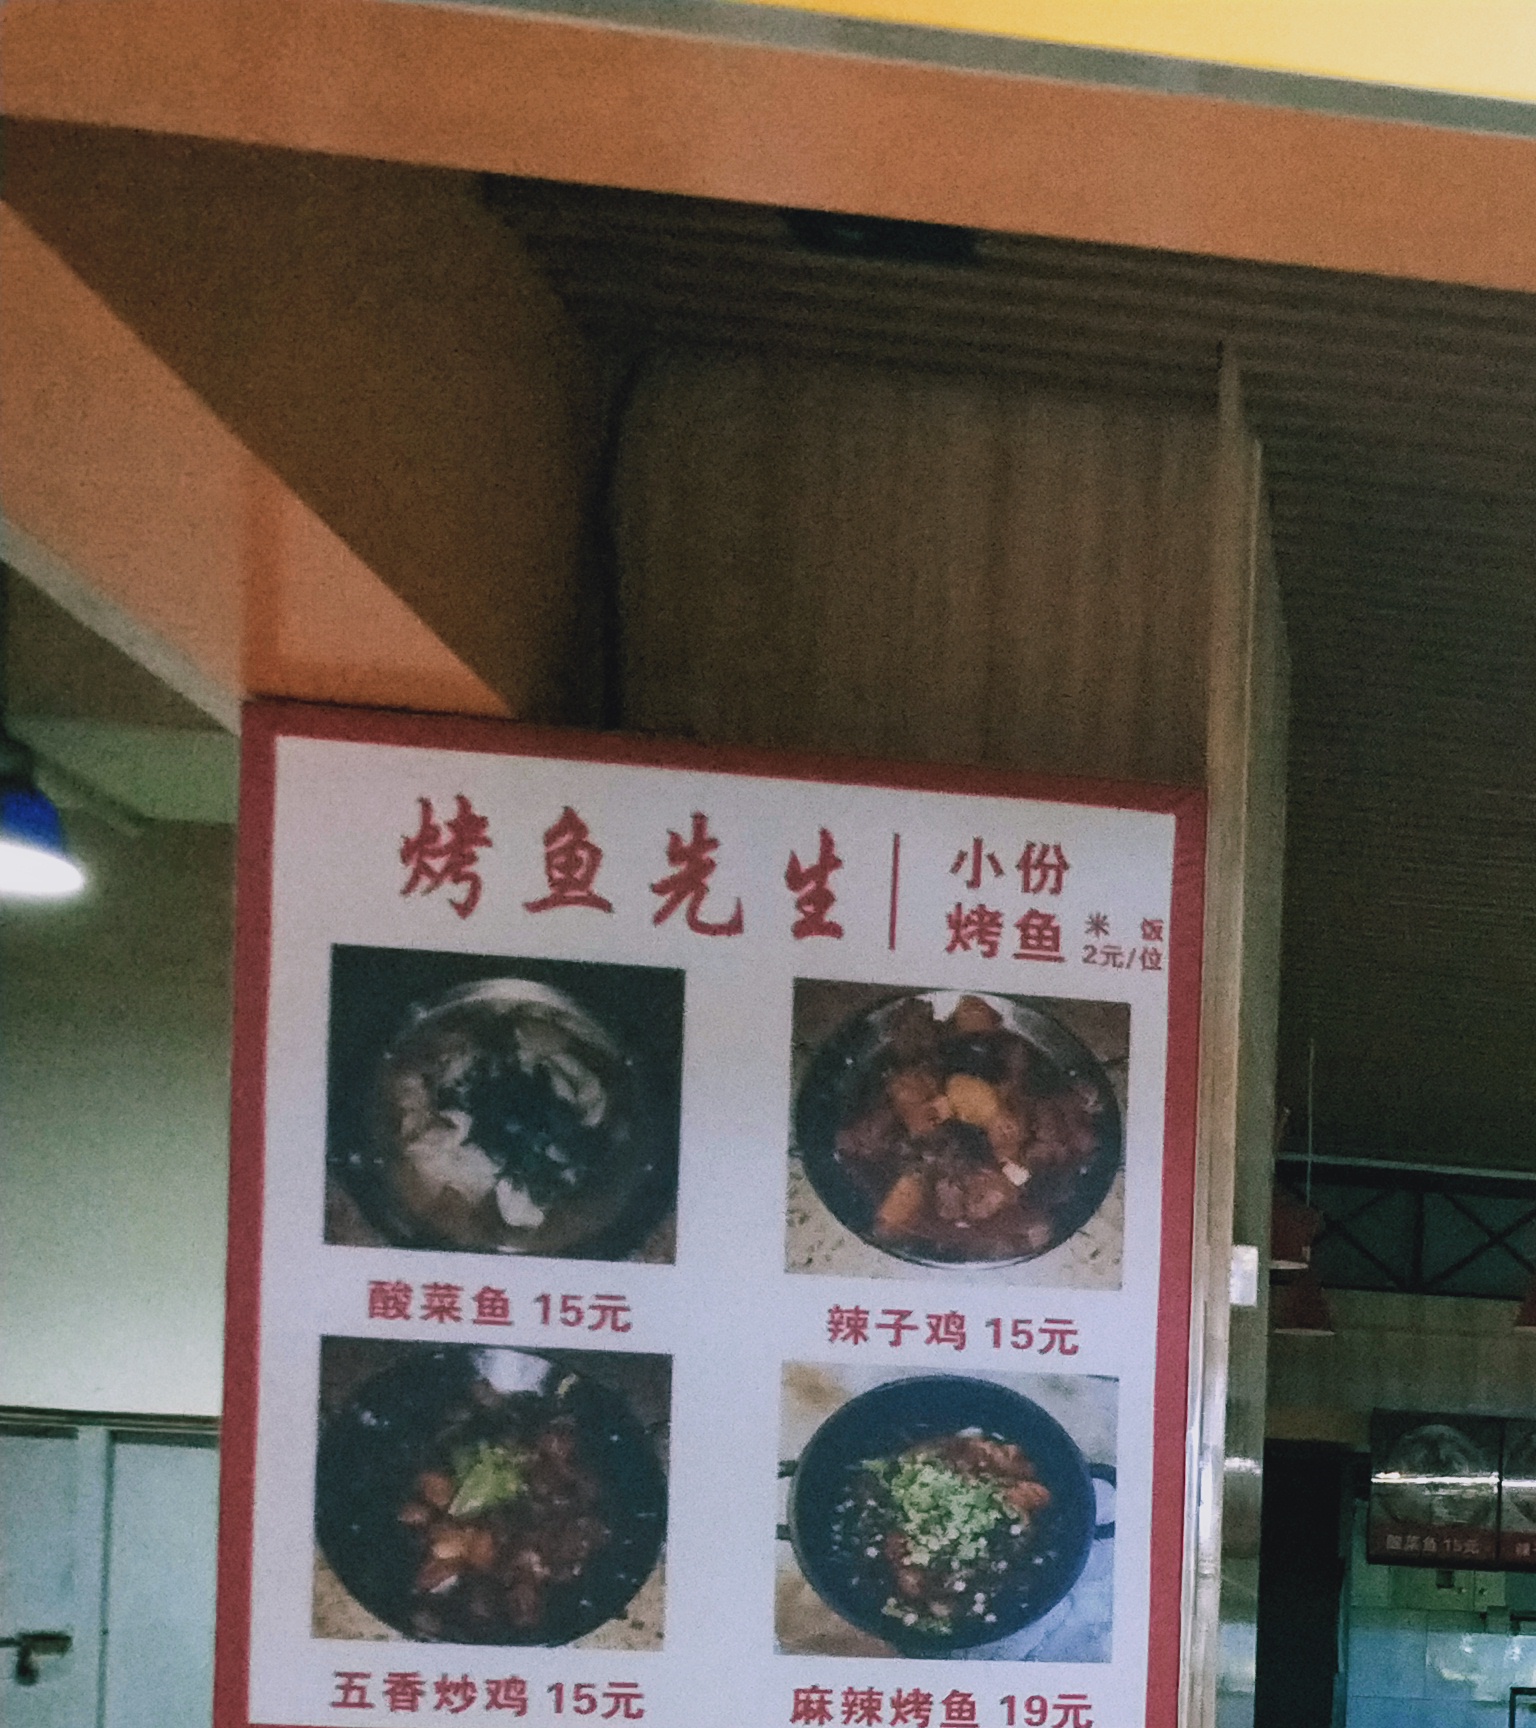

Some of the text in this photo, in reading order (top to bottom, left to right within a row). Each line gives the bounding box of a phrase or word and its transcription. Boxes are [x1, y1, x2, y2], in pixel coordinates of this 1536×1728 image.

[401, 794, 847, 942] 烤鱼先生
[949, 835, 1070, 896] 小份
[944, 901, 1067, 964] 烤鱼
[366, 1279, 632, 1334] 酸菜鱼 15元
[827, 1304, 1080, 1357] 辣子鸡 15元
[331, 1670, 646, 1722] 五香炒鸡 15元
